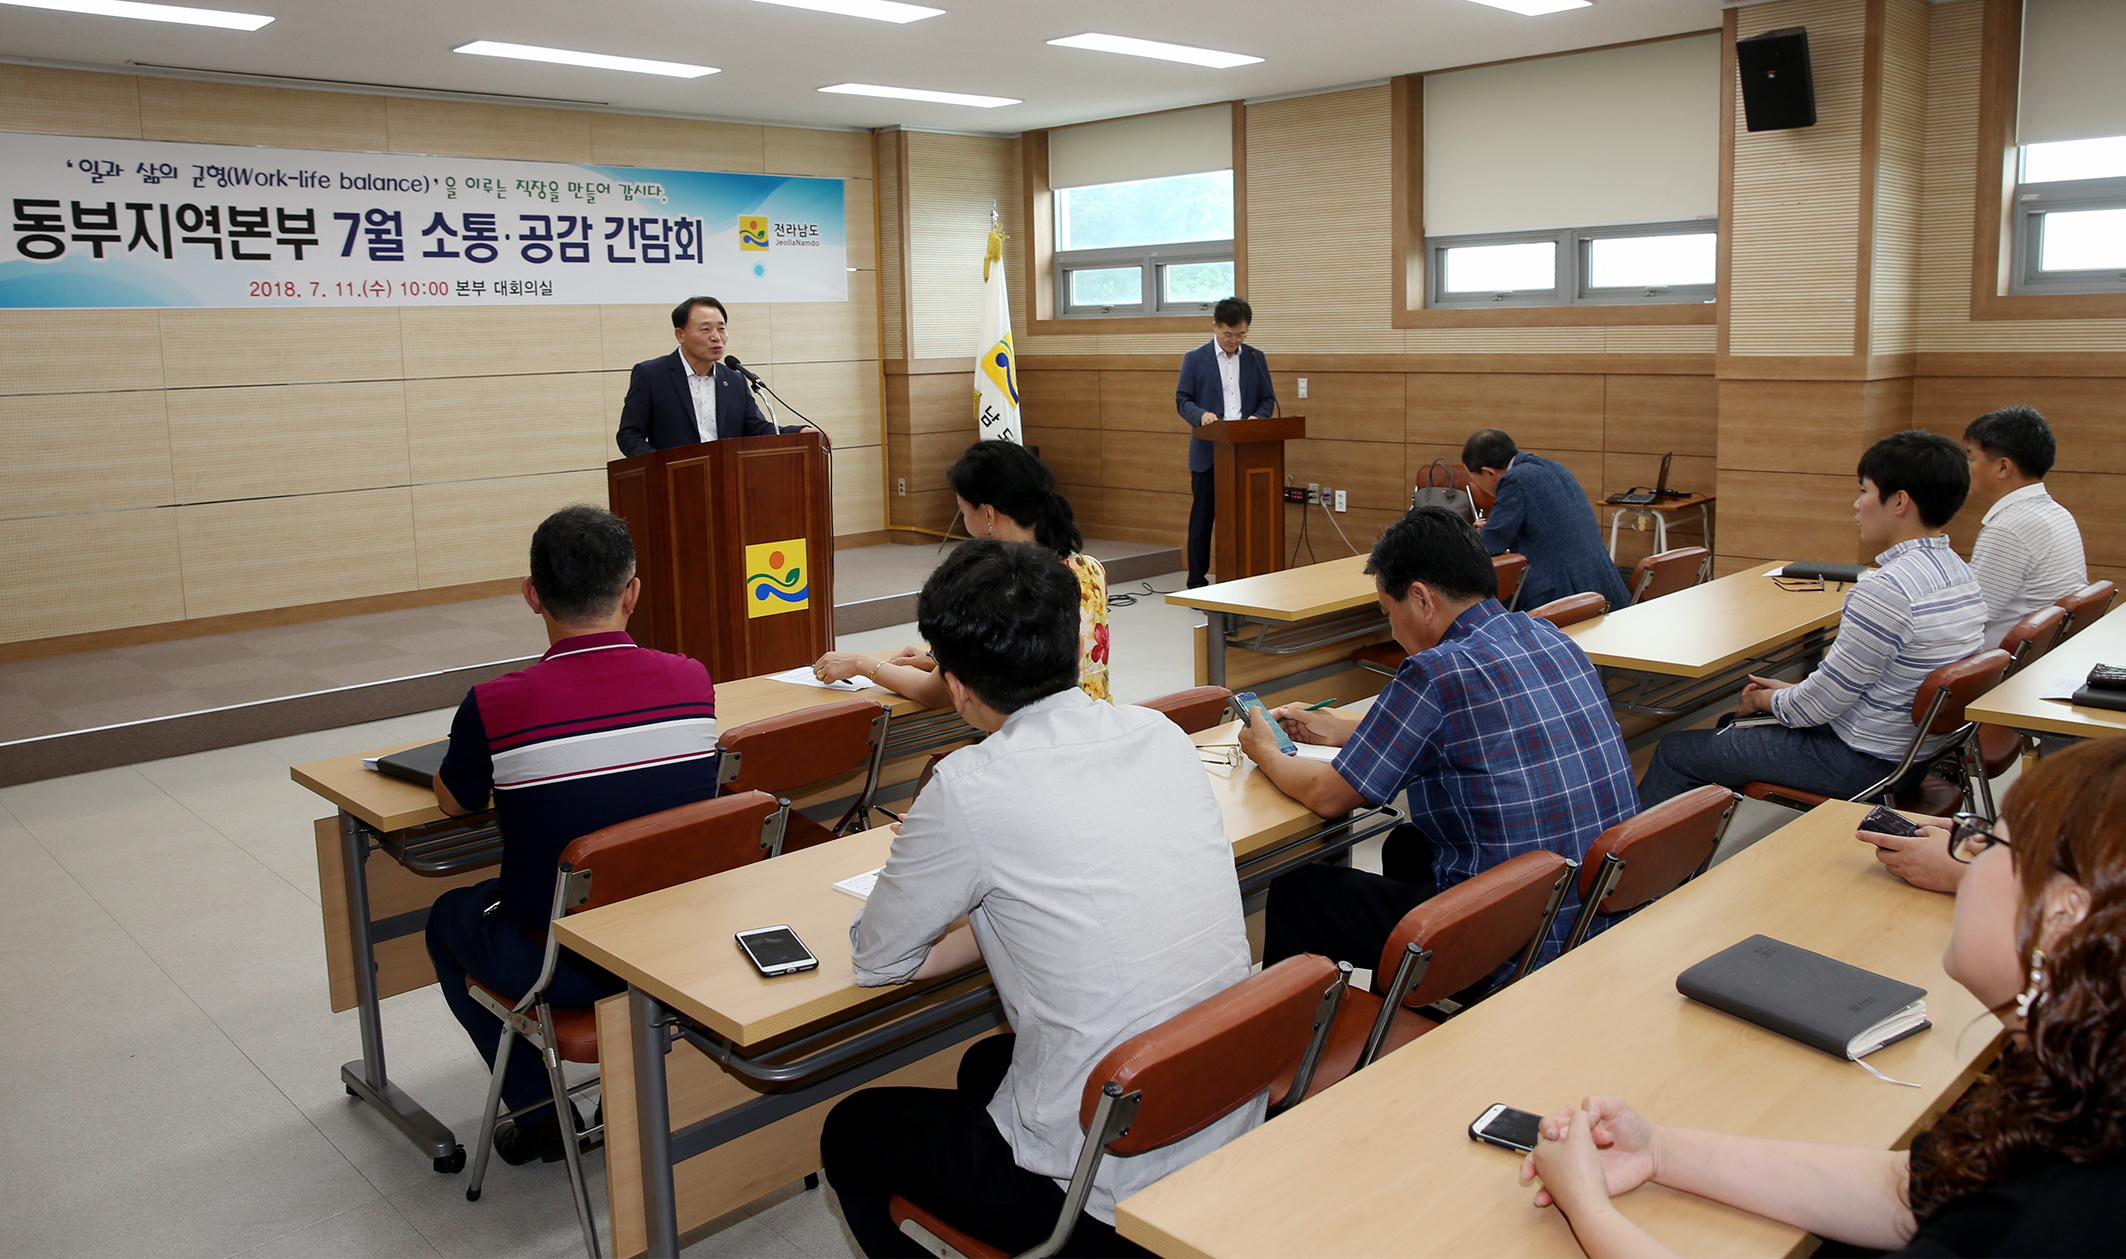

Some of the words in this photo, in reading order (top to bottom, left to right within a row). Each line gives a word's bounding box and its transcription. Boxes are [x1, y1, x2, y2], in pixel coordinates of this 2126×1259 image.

[136, 162, 178, 185] 삶의
[465, 177, 507, 200] 이루는
[515, 178, 560, 203] 직장을
[567, 181, 610, 204] 만들어
[618, 183, 667, 203] 갑시다.
[12, 198, 319, 261] 동부지역본부
[333, 207, 405, 262] 7월
[604, 216, 704, 265] 간담회
[774, 223, 819, 238] 전라남도
[775, 239, 820, 247] JeollaNamdo
[249, 281, 302, 298] 2018.
[309, 281, 326, 298] 7.
[400, 281, 449, 296] 10:00
[455, 280, 487, 297] 본부
[494, 279, 553, 297] 대회의실
